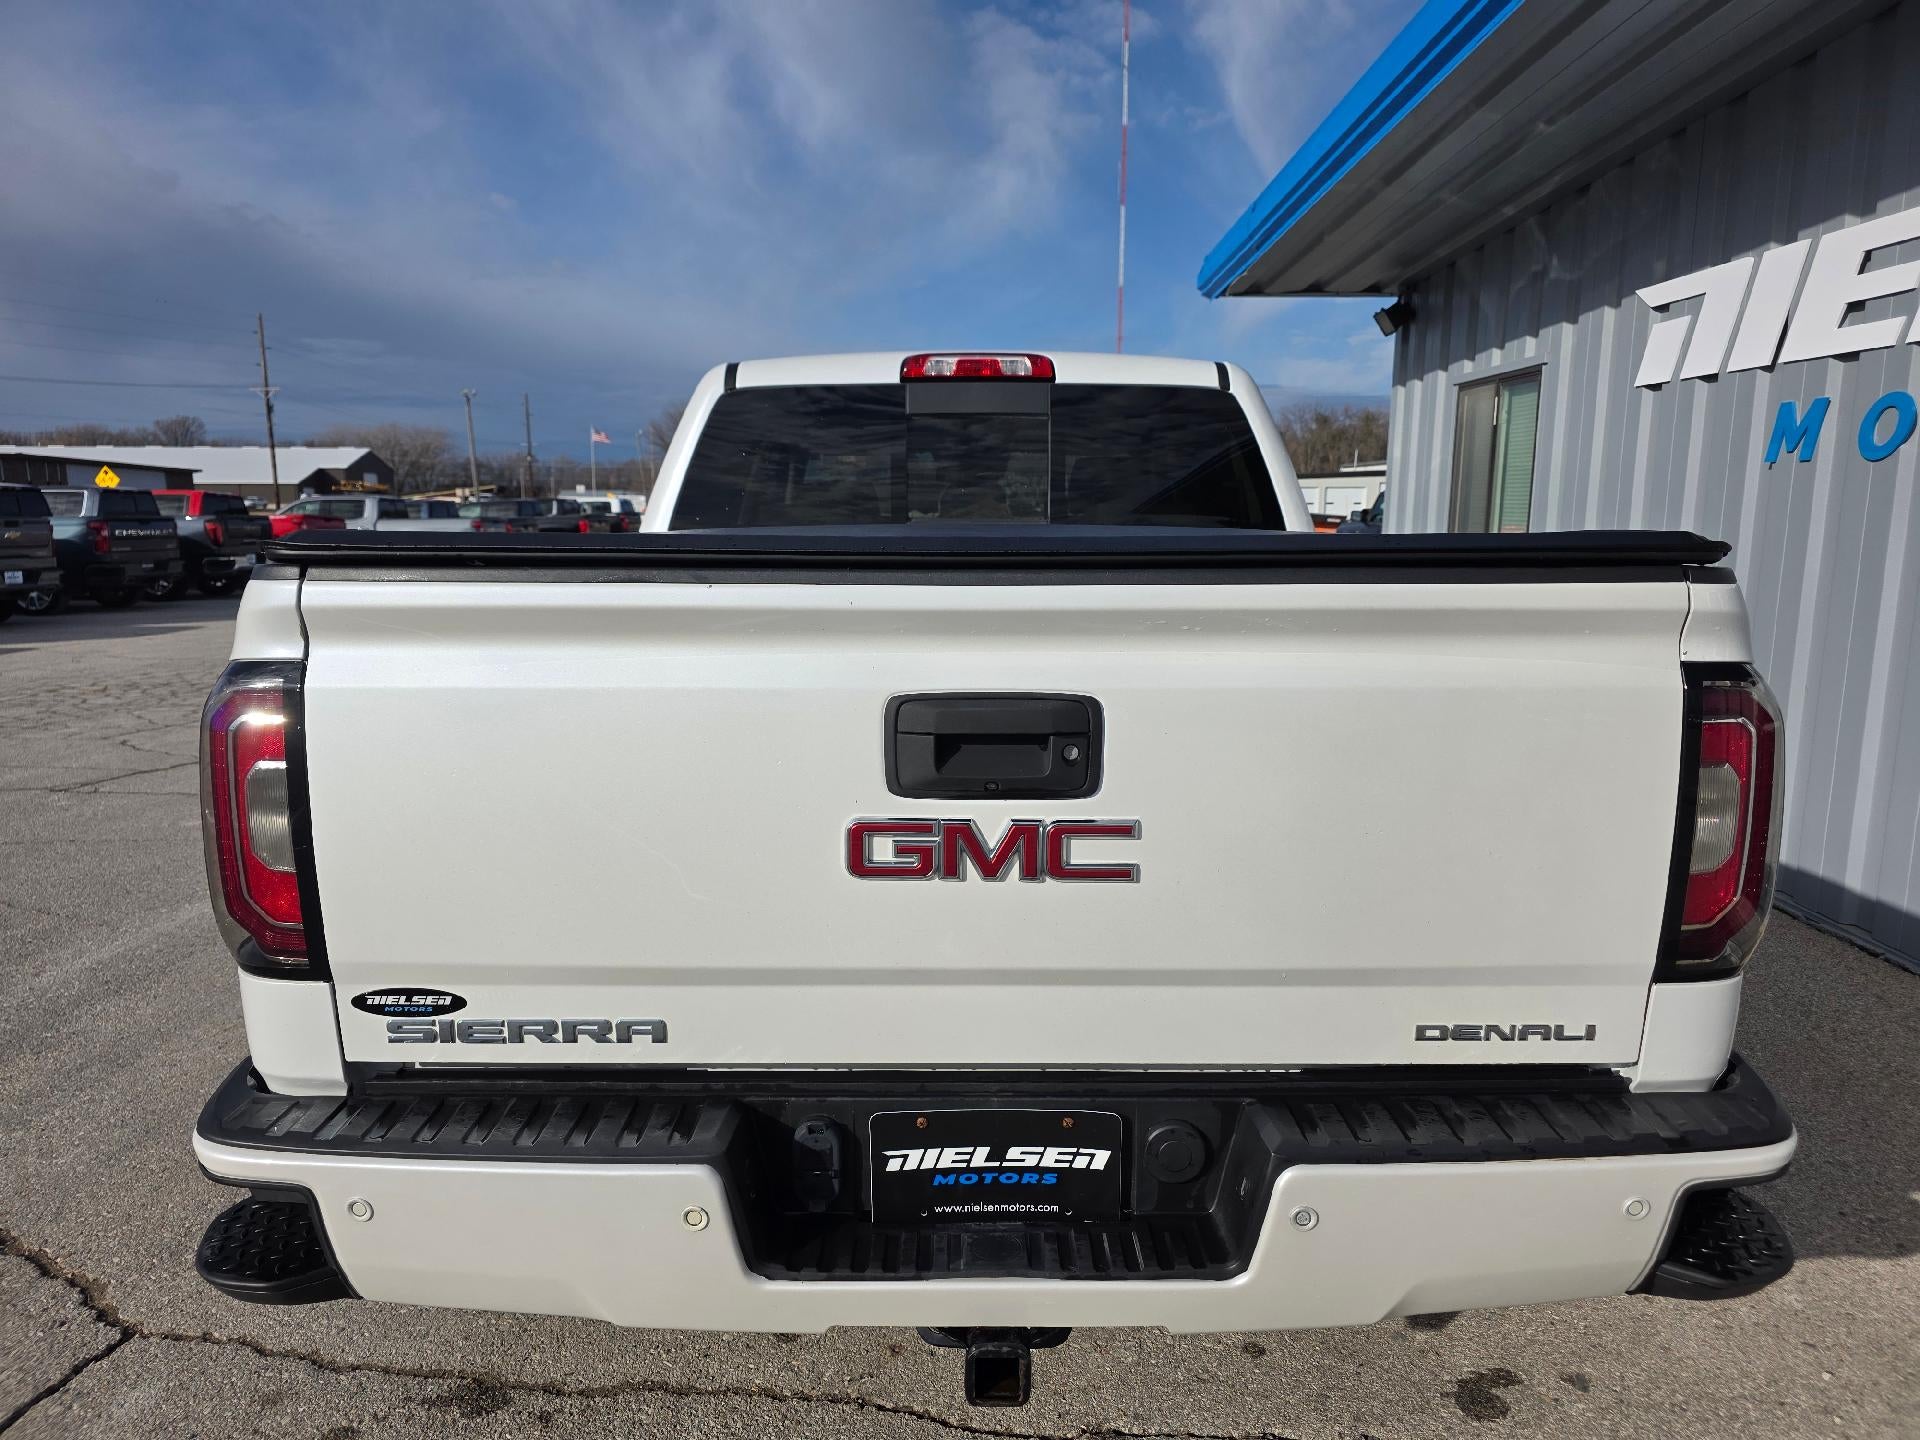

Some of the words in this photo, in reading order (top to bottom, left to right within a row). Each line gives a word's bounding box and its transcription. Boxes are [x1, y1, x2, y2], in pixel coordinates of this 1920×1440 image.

[1635, 206, 1920, 388] NIE
[846, 816, 1142, 883] GMC
[365, 995, 453, 1006] NIELSEN
[386, 1018, 668, 1044] SIERRA
[1415, 1024, 1597, 1042] DENALI
[881, 1146, 1112, 1172] NIELSEN
[932, 1172, 1058, 1186] MOTORS
[934, 1201, 1059, 1214] www.nielsenmotors.com
